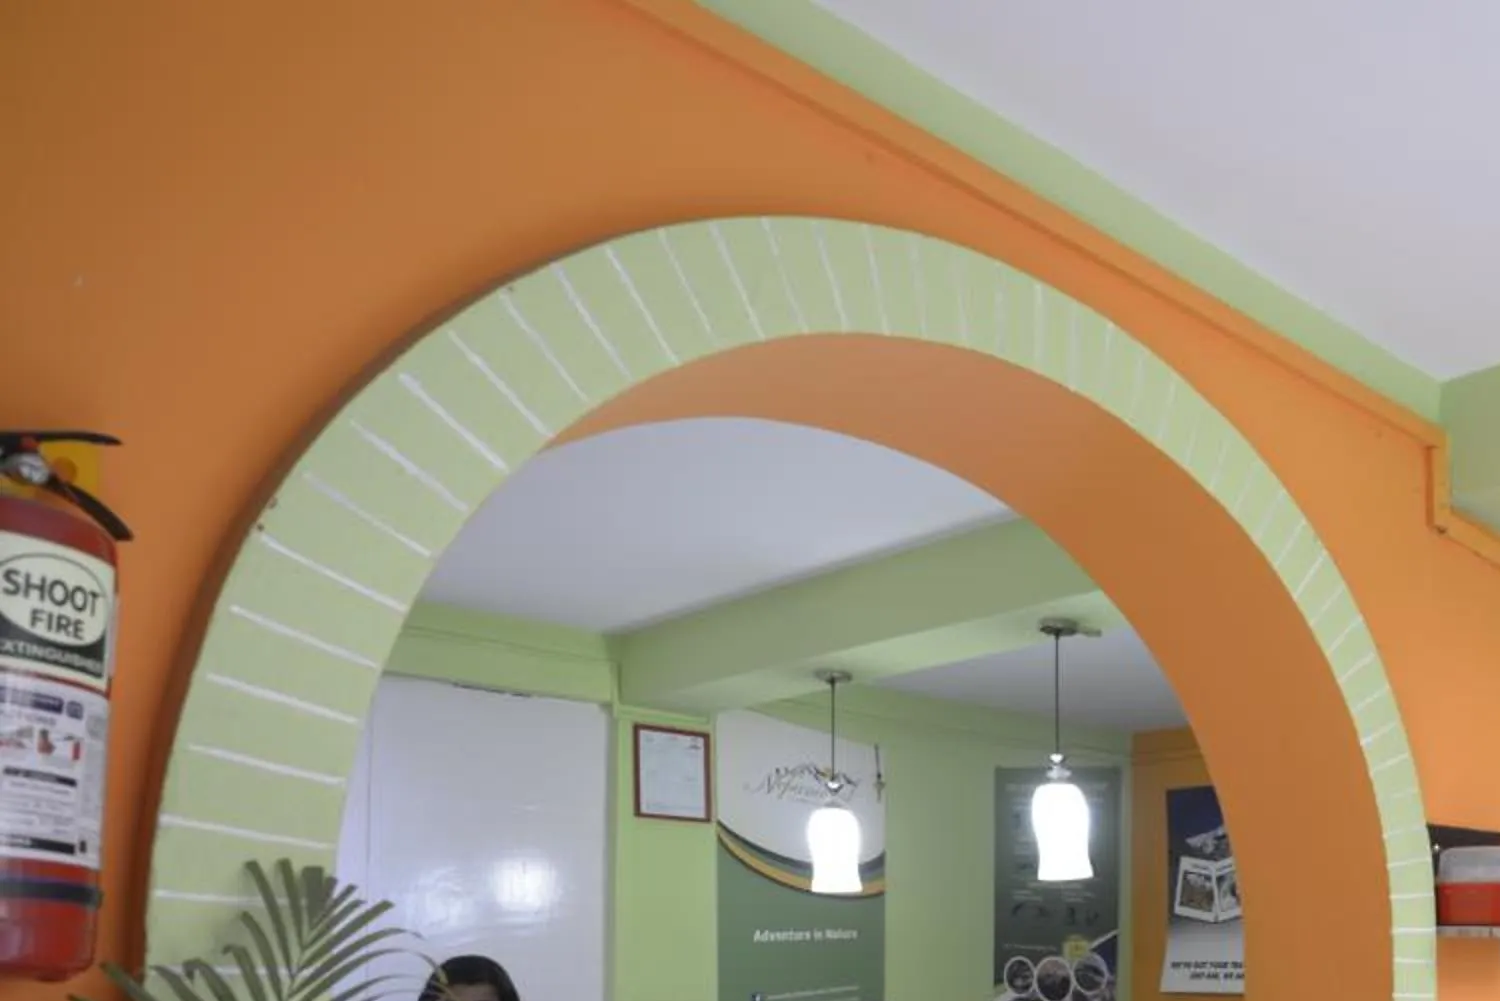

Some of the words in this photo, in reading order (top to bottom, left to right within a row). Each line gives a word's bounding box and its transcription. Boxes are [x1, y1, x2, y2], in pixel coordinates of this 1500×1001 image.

[2, 568, 100, 617] SHOOT
[30, 608, 85, 641] FIRE
[753, 928, 811, 943] Adventure
[813, 928, 823, 941] in
[825, 927, 858, 940] Nature
